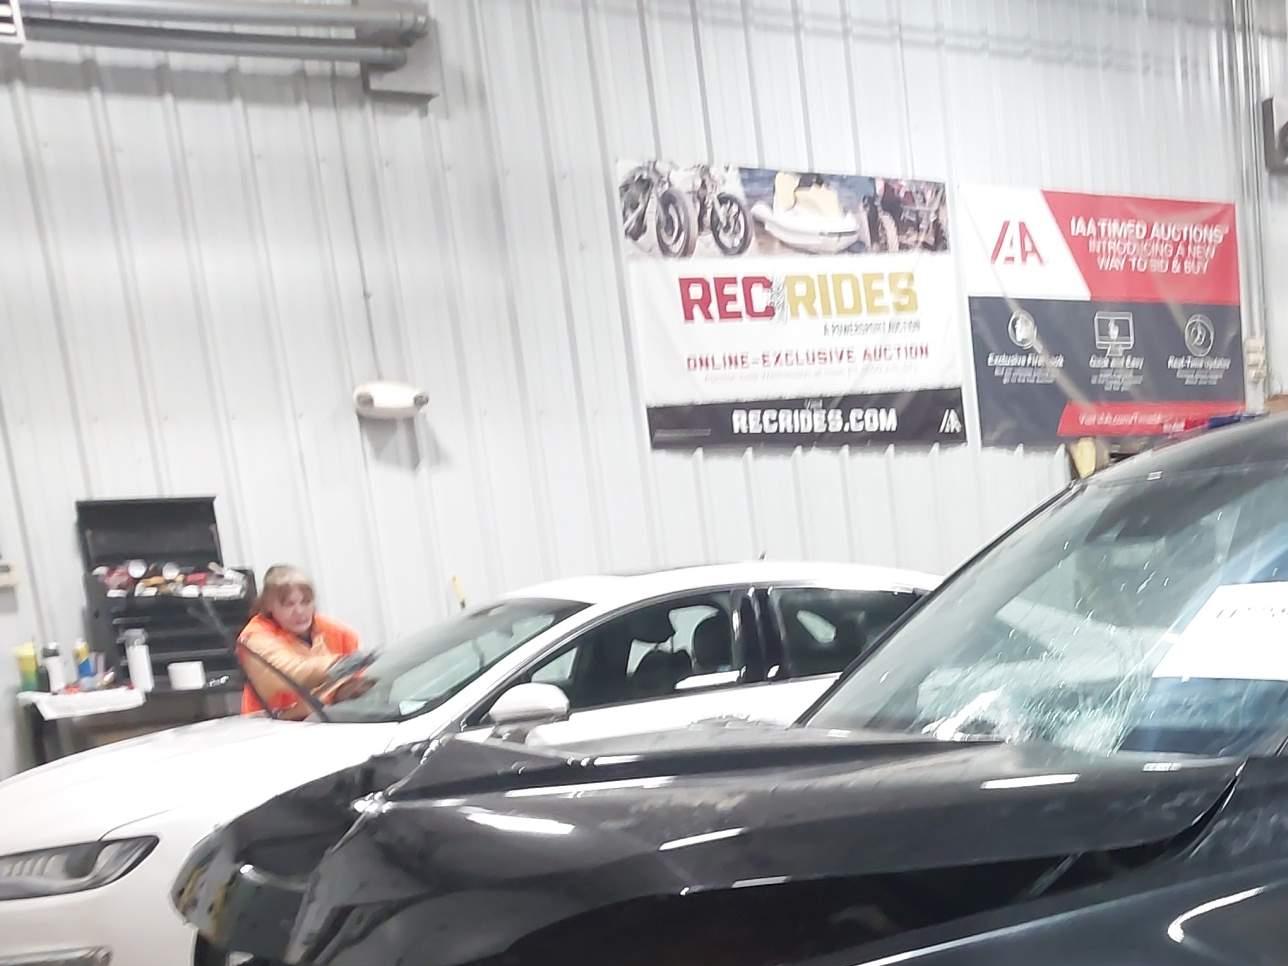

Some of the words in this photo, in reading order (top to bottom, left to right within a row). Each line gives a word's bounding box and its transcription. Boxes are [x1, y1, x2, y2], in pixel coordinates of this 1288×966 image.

[1071, 215, 1096, 237] IAA
[1097, 217, 1147, 240] TIMED
[1187, 242, 1217, 260] NEW
[1097, 256, 1126, 272] WAY
[1127, 256, 1148, 273] TO
[678, 275, 776, 322] REC
[784, 271, 919, 320] RIDES
[686, 348, 855, 371] ONLINE-EXCLUSIVE
[863, 343, 929, 363] AUCTION
[732, 407, 898, 434] RECRIDES.COM
